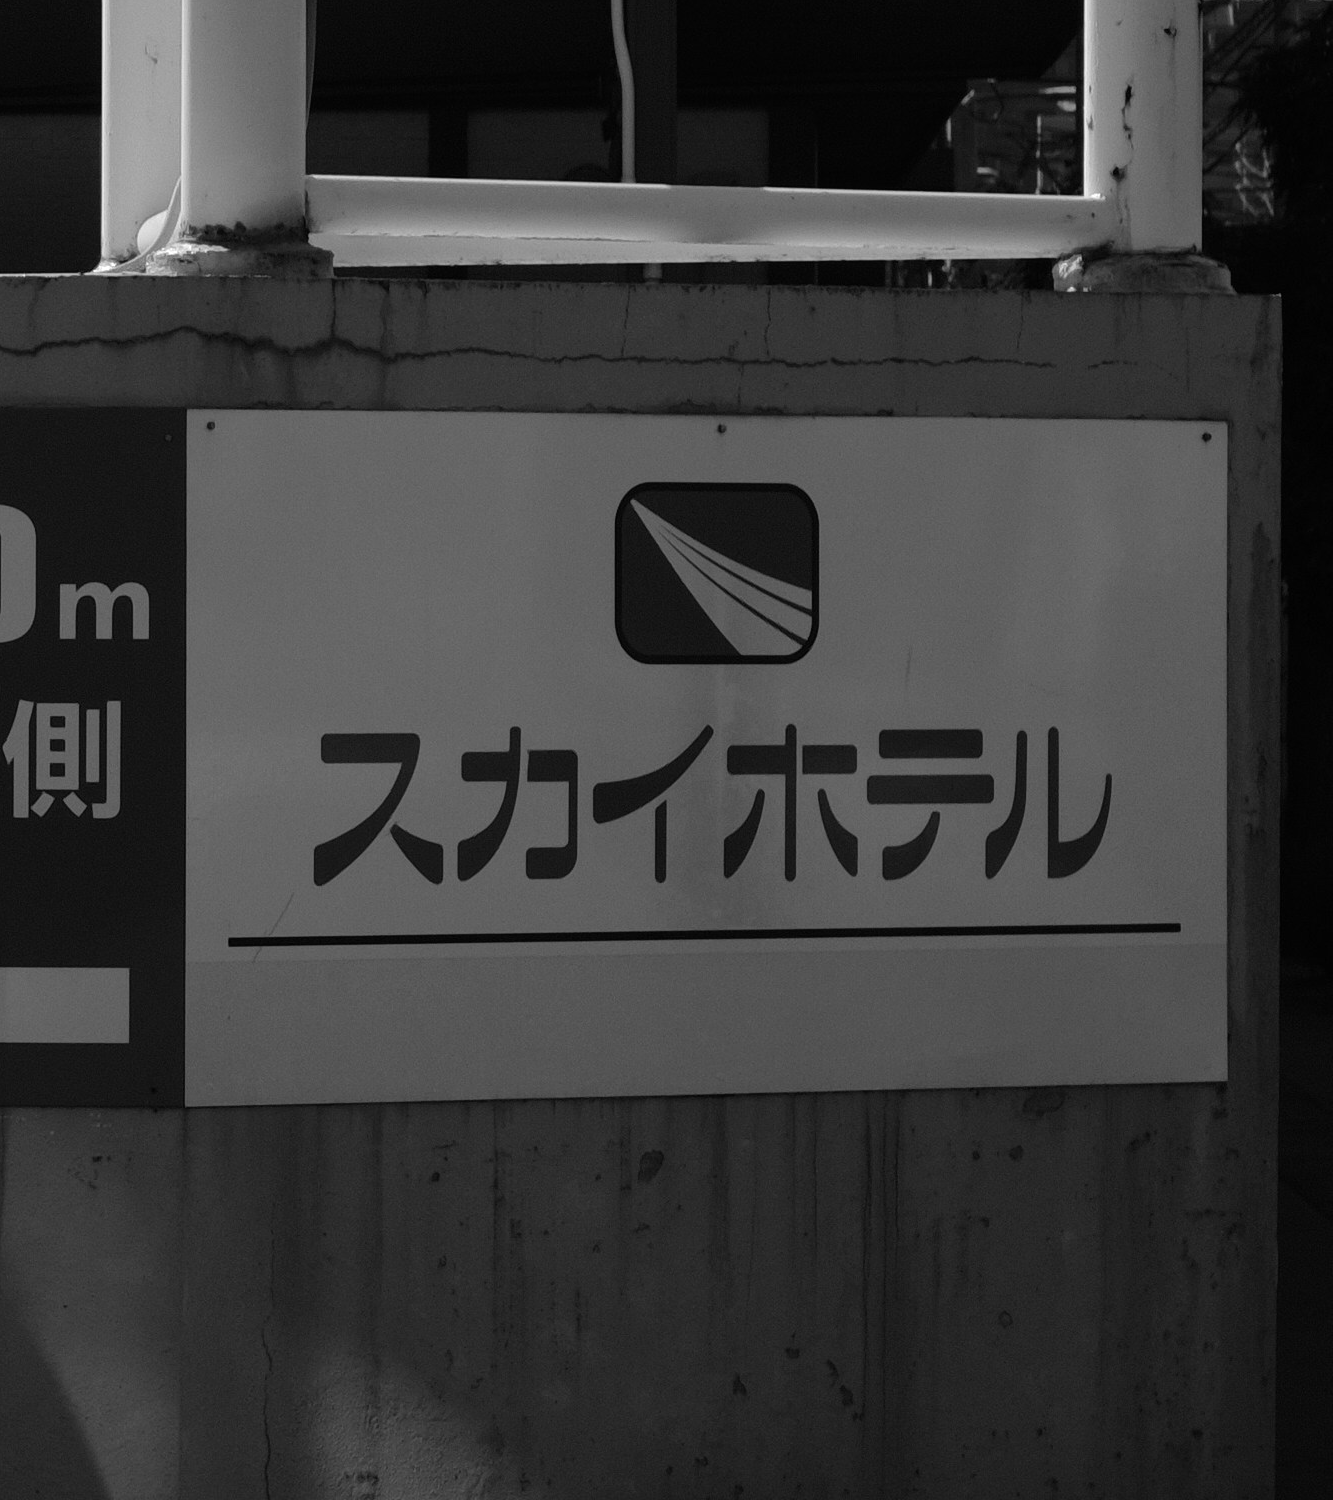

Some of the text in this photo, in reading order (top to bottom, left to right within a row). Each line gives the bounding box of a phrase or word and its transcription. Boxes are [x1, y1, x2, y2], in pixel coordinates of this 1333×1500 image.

[313, 723, 1113, 887] スカイホテル
